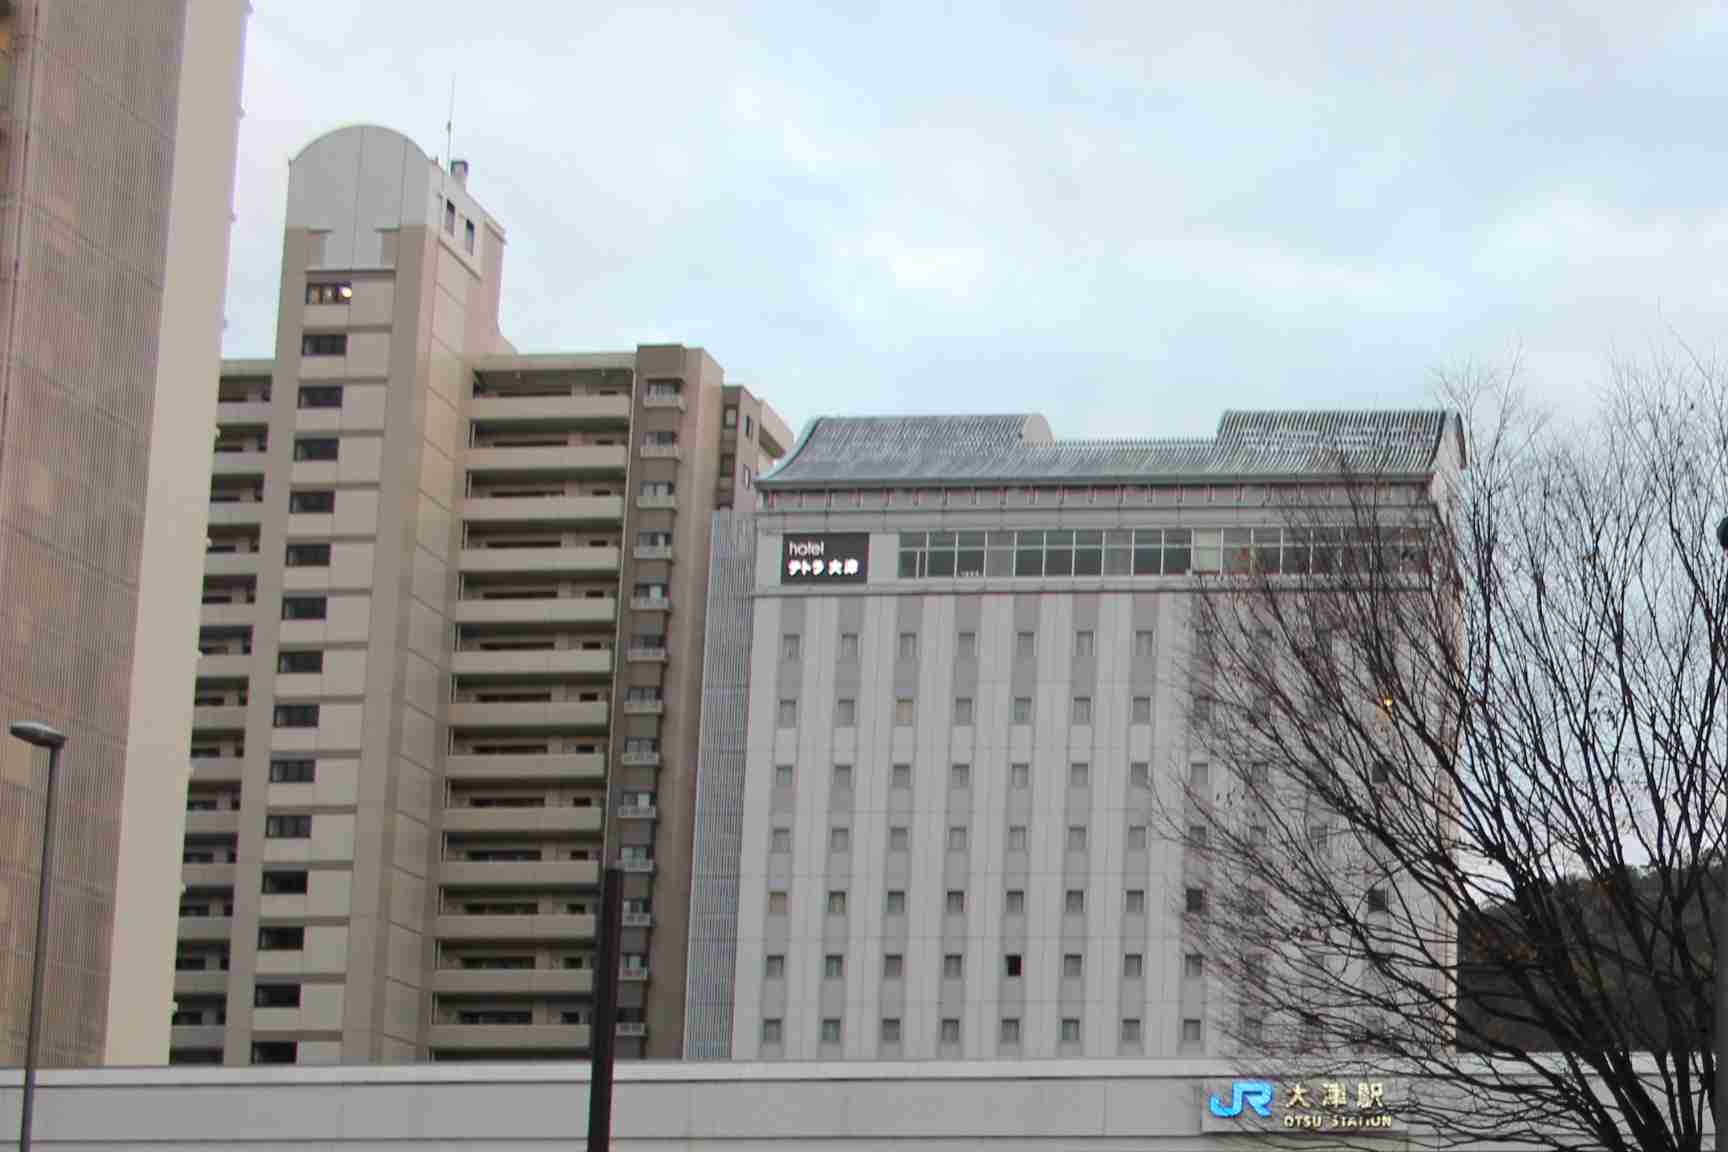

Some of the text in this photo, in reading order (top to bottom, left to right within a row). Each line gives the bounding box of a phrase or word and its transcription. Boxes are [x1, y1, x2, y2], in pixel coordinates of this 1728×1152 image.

[788, 541, 825, 556] hotel
[1210, 1081, 1273, 1118] JR
[1286, 1083, 1384, 1109] 大津駅
[1284, 1115, 1392, 1128] OTSU STATION
